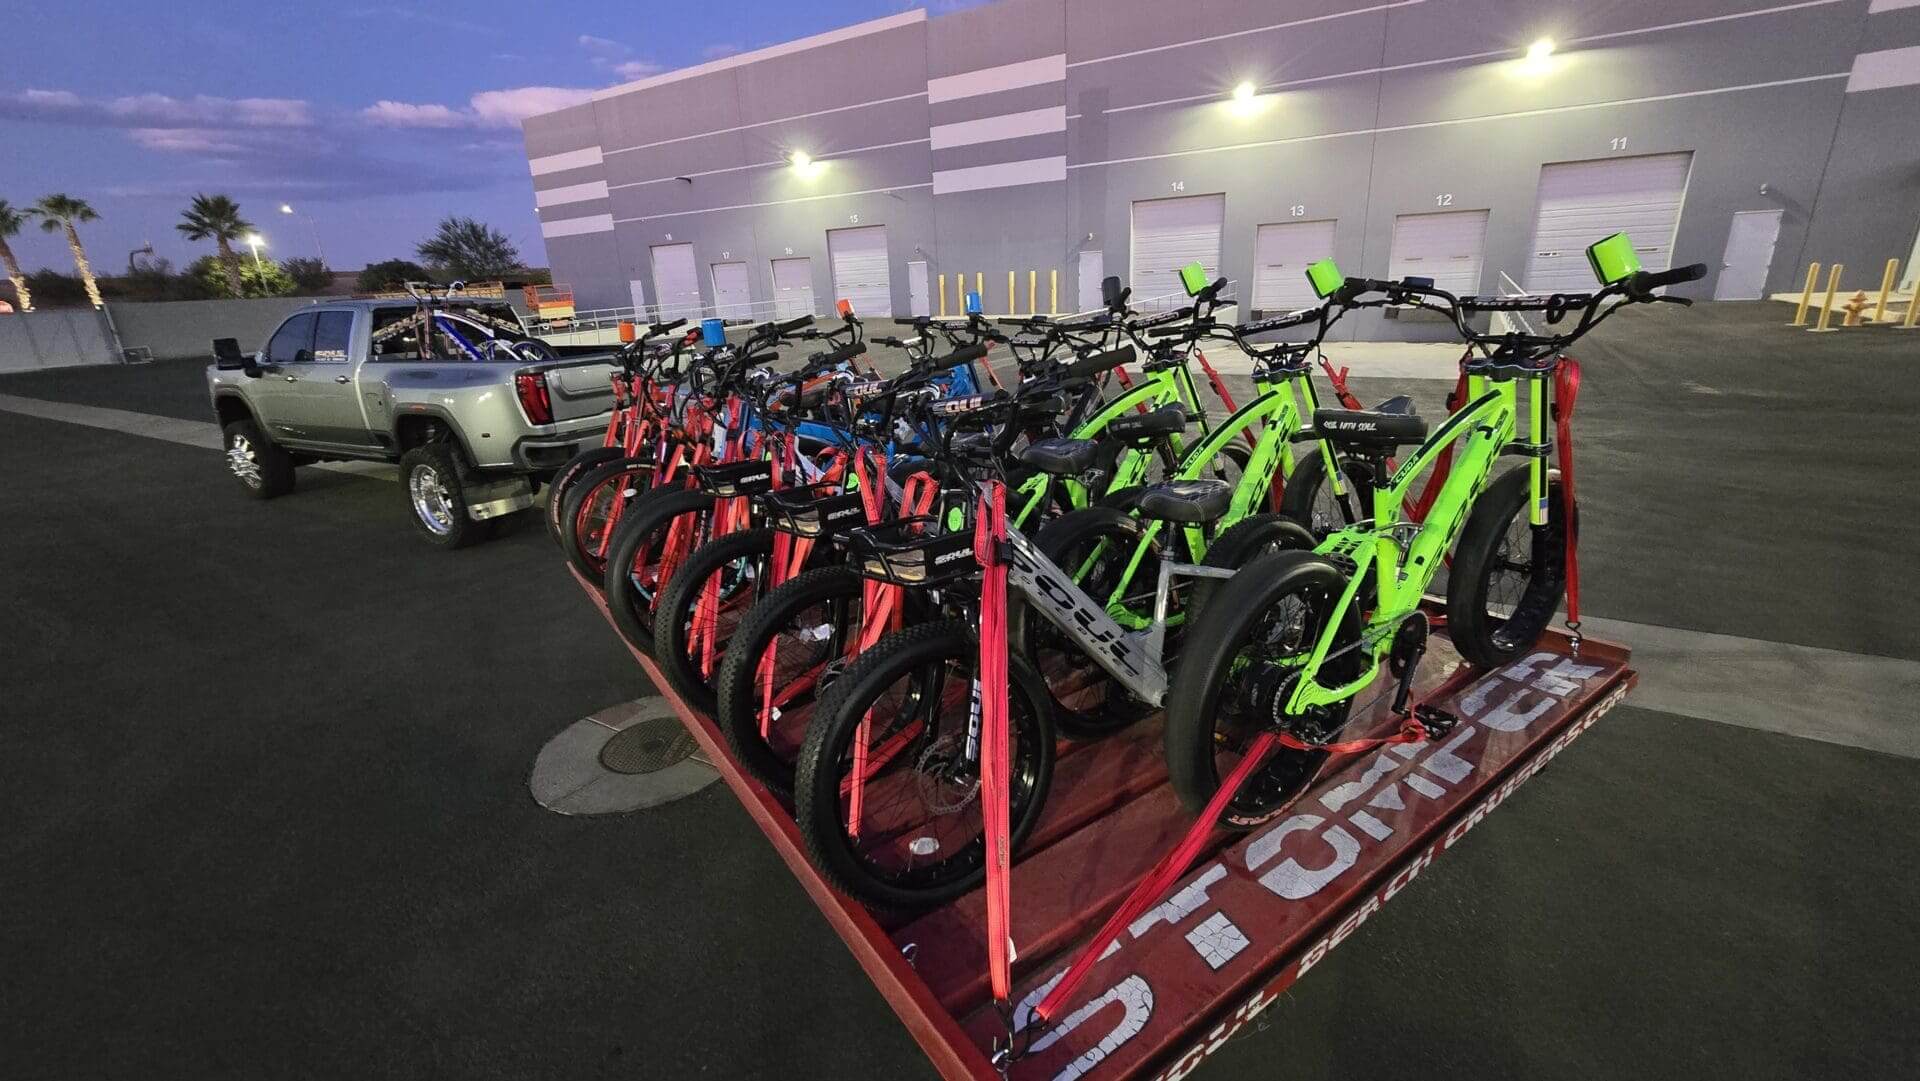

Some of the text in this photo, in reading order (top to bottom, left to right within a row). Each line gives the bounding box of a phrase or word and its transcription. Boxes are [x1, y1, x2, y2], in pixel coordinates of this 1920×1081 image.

[1609, 136, 1628, 151] 11
[1170, 181, 1185, 192] 14
[1435, 193, 1453, 207] 12
[1290, 205, 1305, 217] 13
[849, 213, 859, 224] 15
[722, 251, 730, 260] 17
[785, 247, 794, 256] 16
[1296, 846, 1435, 980] BEACH
